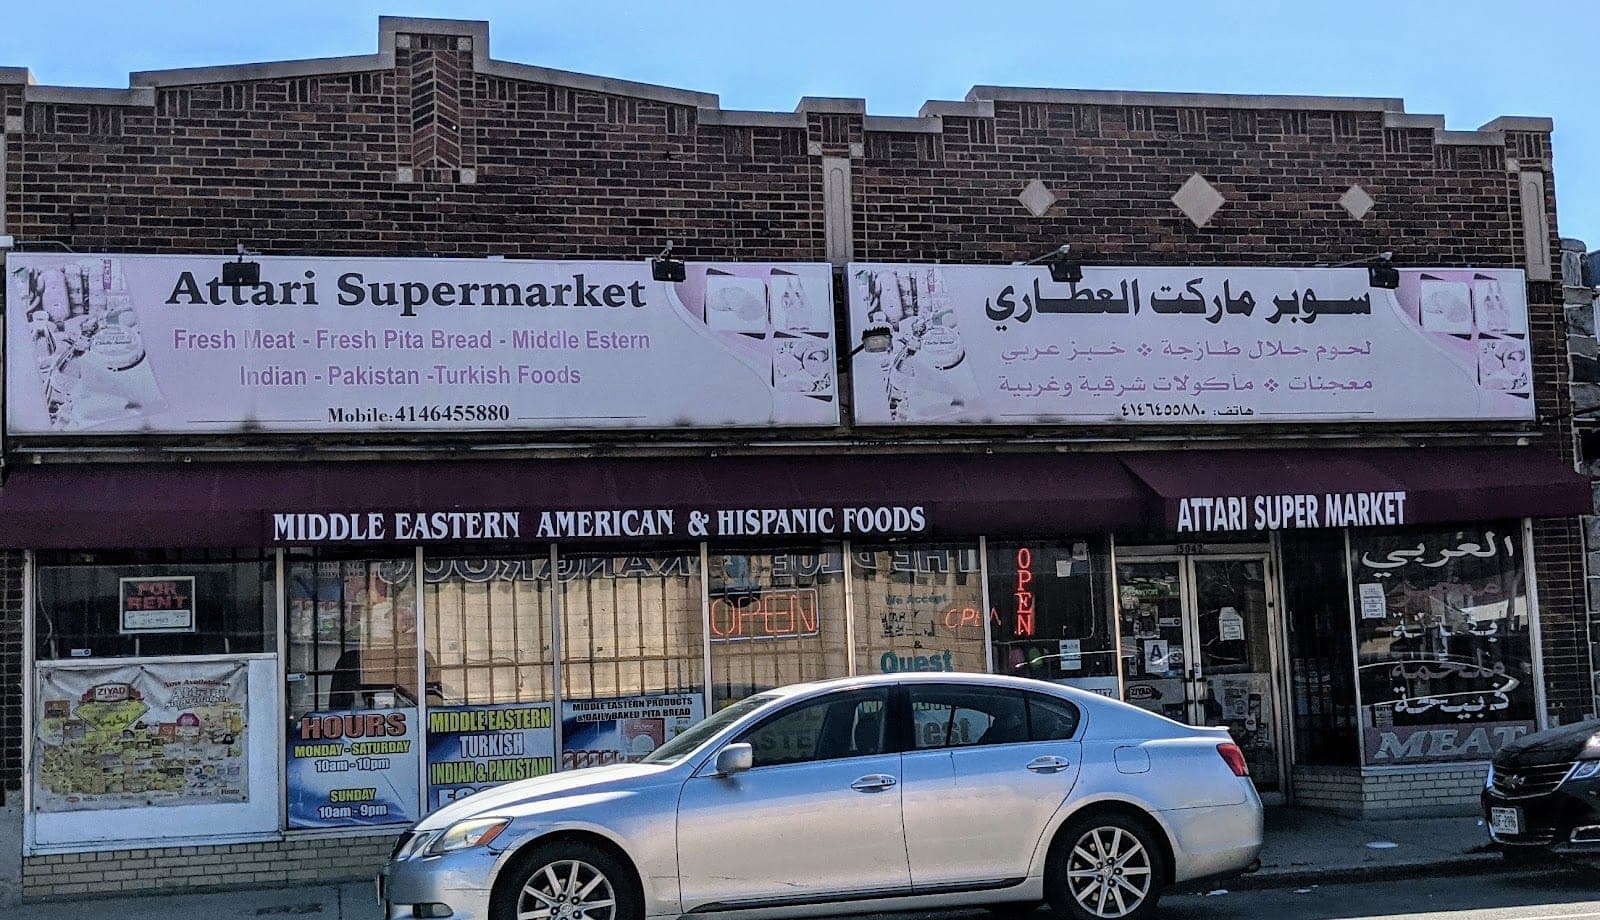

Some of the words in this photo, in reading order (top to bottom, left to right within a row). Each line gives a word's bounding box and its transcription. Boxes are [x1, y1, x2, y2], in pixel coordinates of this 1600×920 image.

[165, 270, 318, 305] Attari
[337, 272, 647, 316] Supermarket
[1150, 277, 1256, 324] ماركت
[985, 277, 1141, 332] العطاري
[1264, 287, 1371, 325] سوبر
[173, 329, 236, 350] Fresh
[243, 330, 296, 349] Meat
[316, 330, 377, 349] Fresh
[383, 330, 424, 350] Pita
[431, 330, 493, 349] Bread
[512, 330, 579, 349] Middle
[586, 331, 650, 349] Estern
[1162, 339, 1241, 361] طازجة
[1248, 340, 1308, 360] حلال
[1001, 343, 1060, 364] عربي
[1067, 341, 1125, 361] خبز
[1315, 340, 1372, 361] لحوم
[240, 366, 307, 386] Indian
[328, 367, 419, 385] Pakistan
[517, 365, 581, 384] Foods
[999, 375, 1073, 396] وغربية
[1079, 375, 1146, 396] شرقية
[1288, 375, 1373, 395] معجنات
[1177, 496, 1248, 532] ATTARI
[1254, 494, 1319, 530] SUPER
[1325, 491, 1406, 527] MARKET
[273, 512, 386, 541] MIDDLE
[394, 512, 520, 540] EASTERN
[535, 509, 675, 537] AMERICAN
[687, 509, 709, 536] &
[717, 507, 835, 536] HISPANIC
[843, 506, 926, 533] FOODS
[138, 582, 177, 596] FOR
[1014, 548, 1035, 636] OPEN
[127, 596, 187, 609] RENT
[710, 595, 816, 636] OPEN
[881, 648, 954, 674] Quest
[97, 686, 126, 696] ZIYAD
[1130, 687, 1152, 696] ZIYAD
[572, 702, 605, 711] MIDDLE
[607, 699, 644, 709] EASTERN
[647, 697, 693, 707] PRODUCTS
[611, 710, 640, 719] BAKED
[642, 708, 660, 717] PITA
[663, 707, 691, 716] BREAD
[301, 712, 407, 740] HOURS
[430, 710, 486, 733] MIDDLE
[488, 707, 551, 730] EASTERN
[294, 743, 344, 758] MONDAY
[351, 740, 411, 755] SATURDAY
[460, 733, 524, 758] TURKISH
[1374, 725, 1528, 759] MEAT
[315, 758, 349, 772] 10am
[355, 757, 390, 773] 10pm
[432, 761, 475, 785] INDIAN
[476, 764, 487, 782] &
[330, 788, 377, 802] SUNDAY
[319, 806, 351, 819] 10am
[360, 804, 387, 818] 9pm
